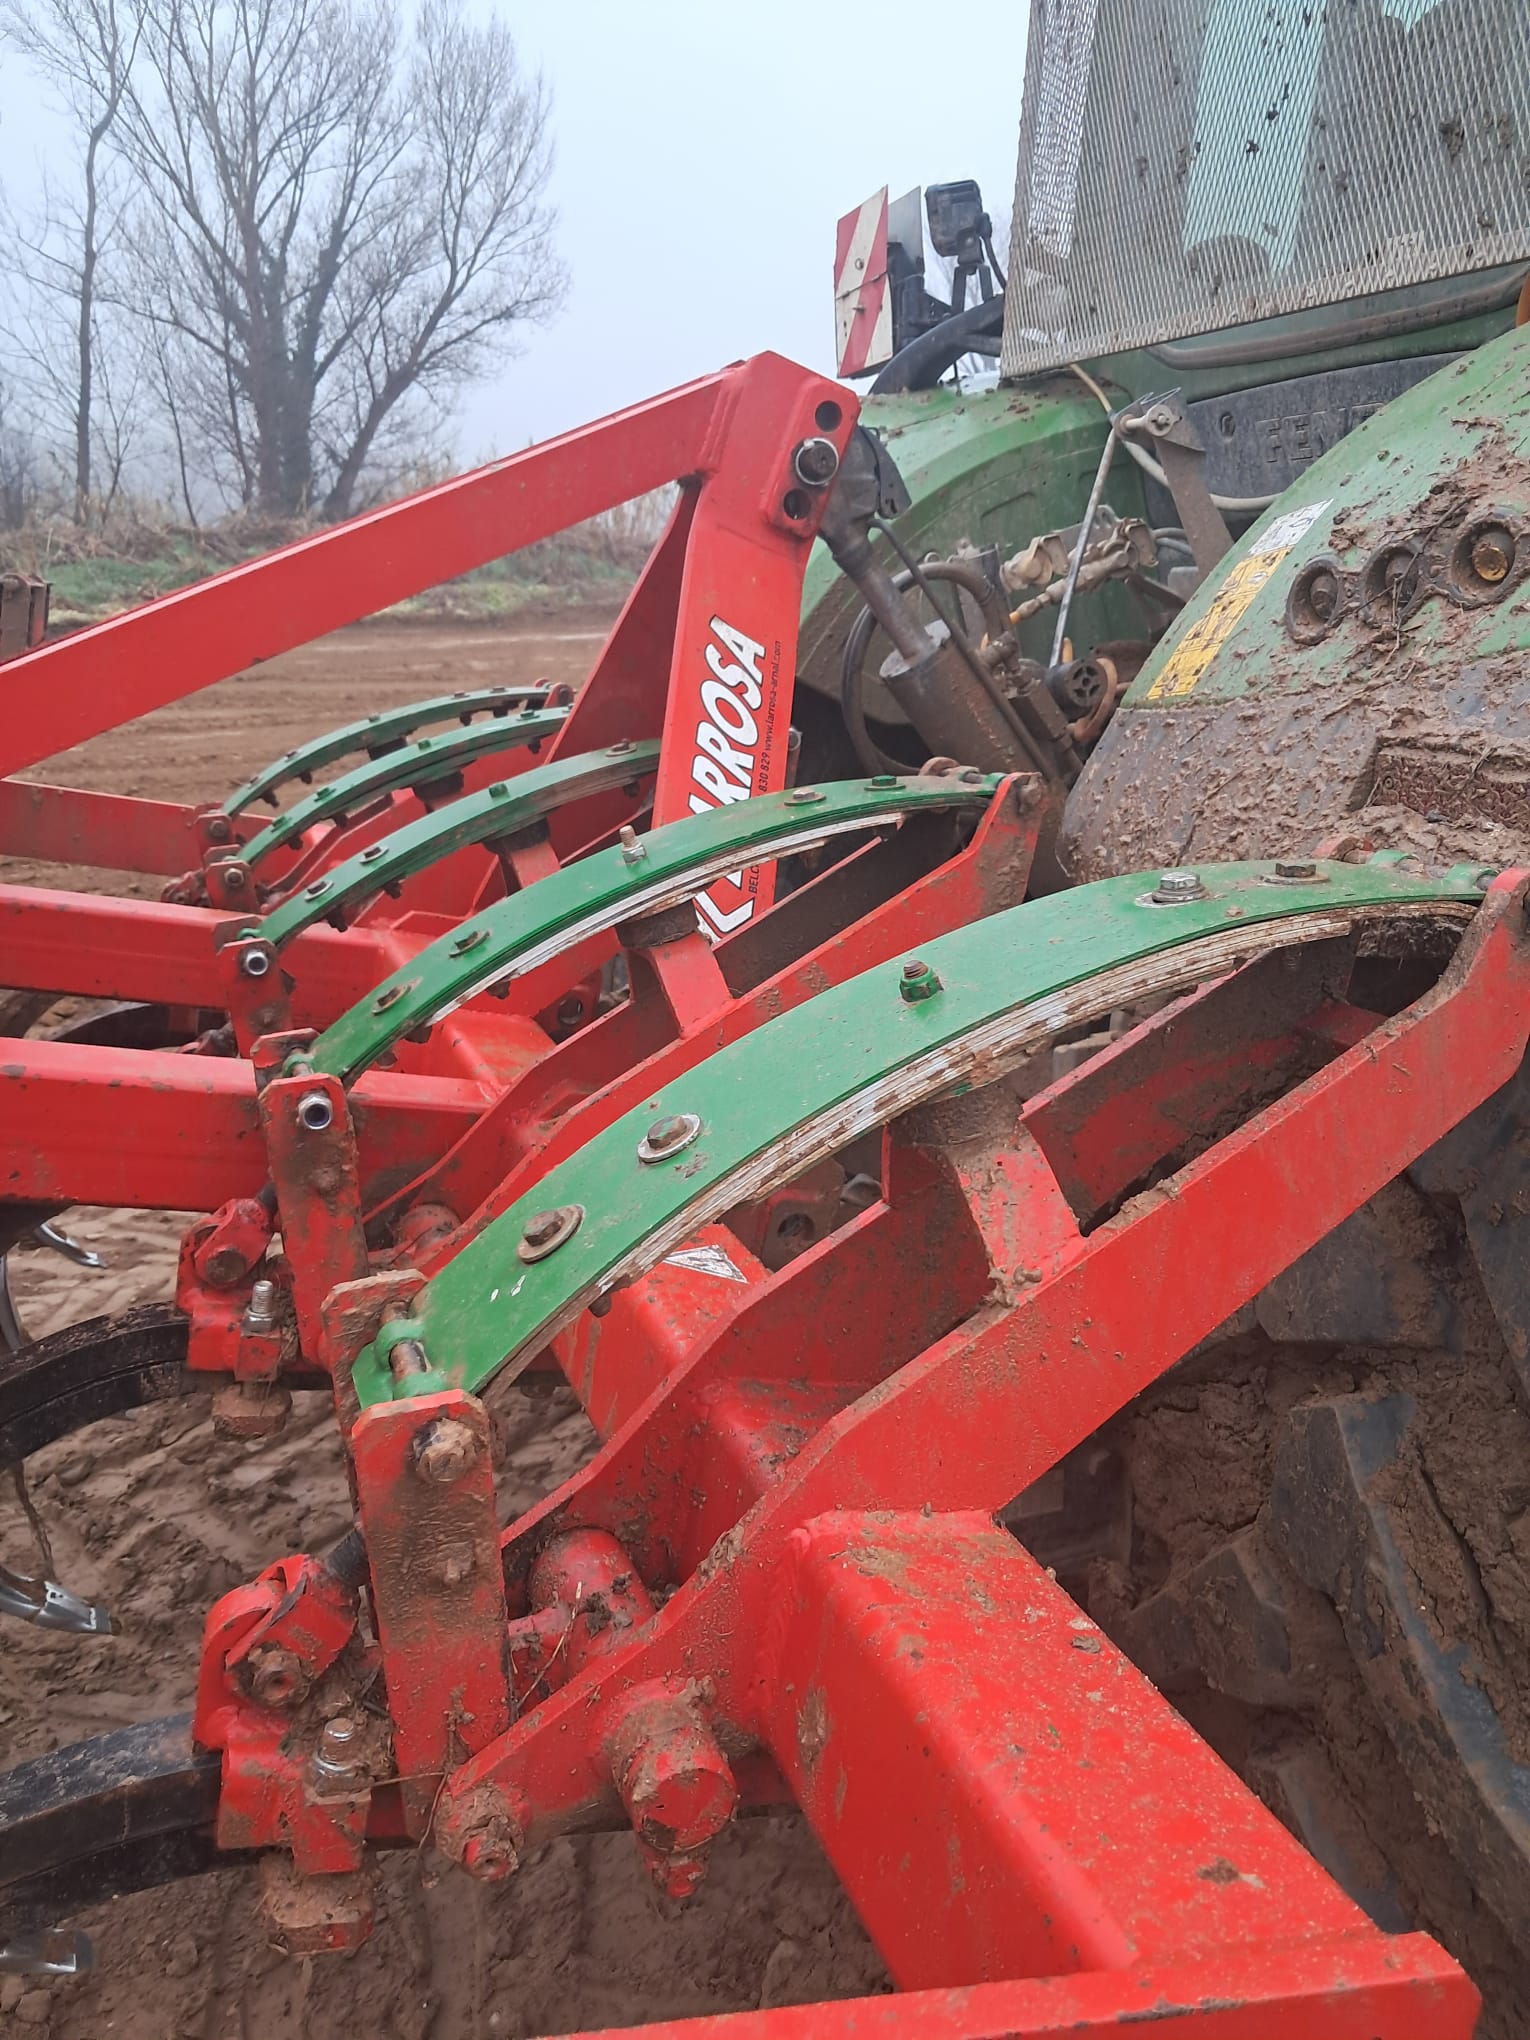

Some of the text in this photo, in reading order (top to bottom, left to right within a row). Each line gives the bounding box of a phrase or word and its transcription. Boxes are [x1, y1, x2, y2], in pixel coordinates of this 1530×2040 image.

[749, 641, 781, 894] BELC 830 829 www.larrosa-arnal.com
